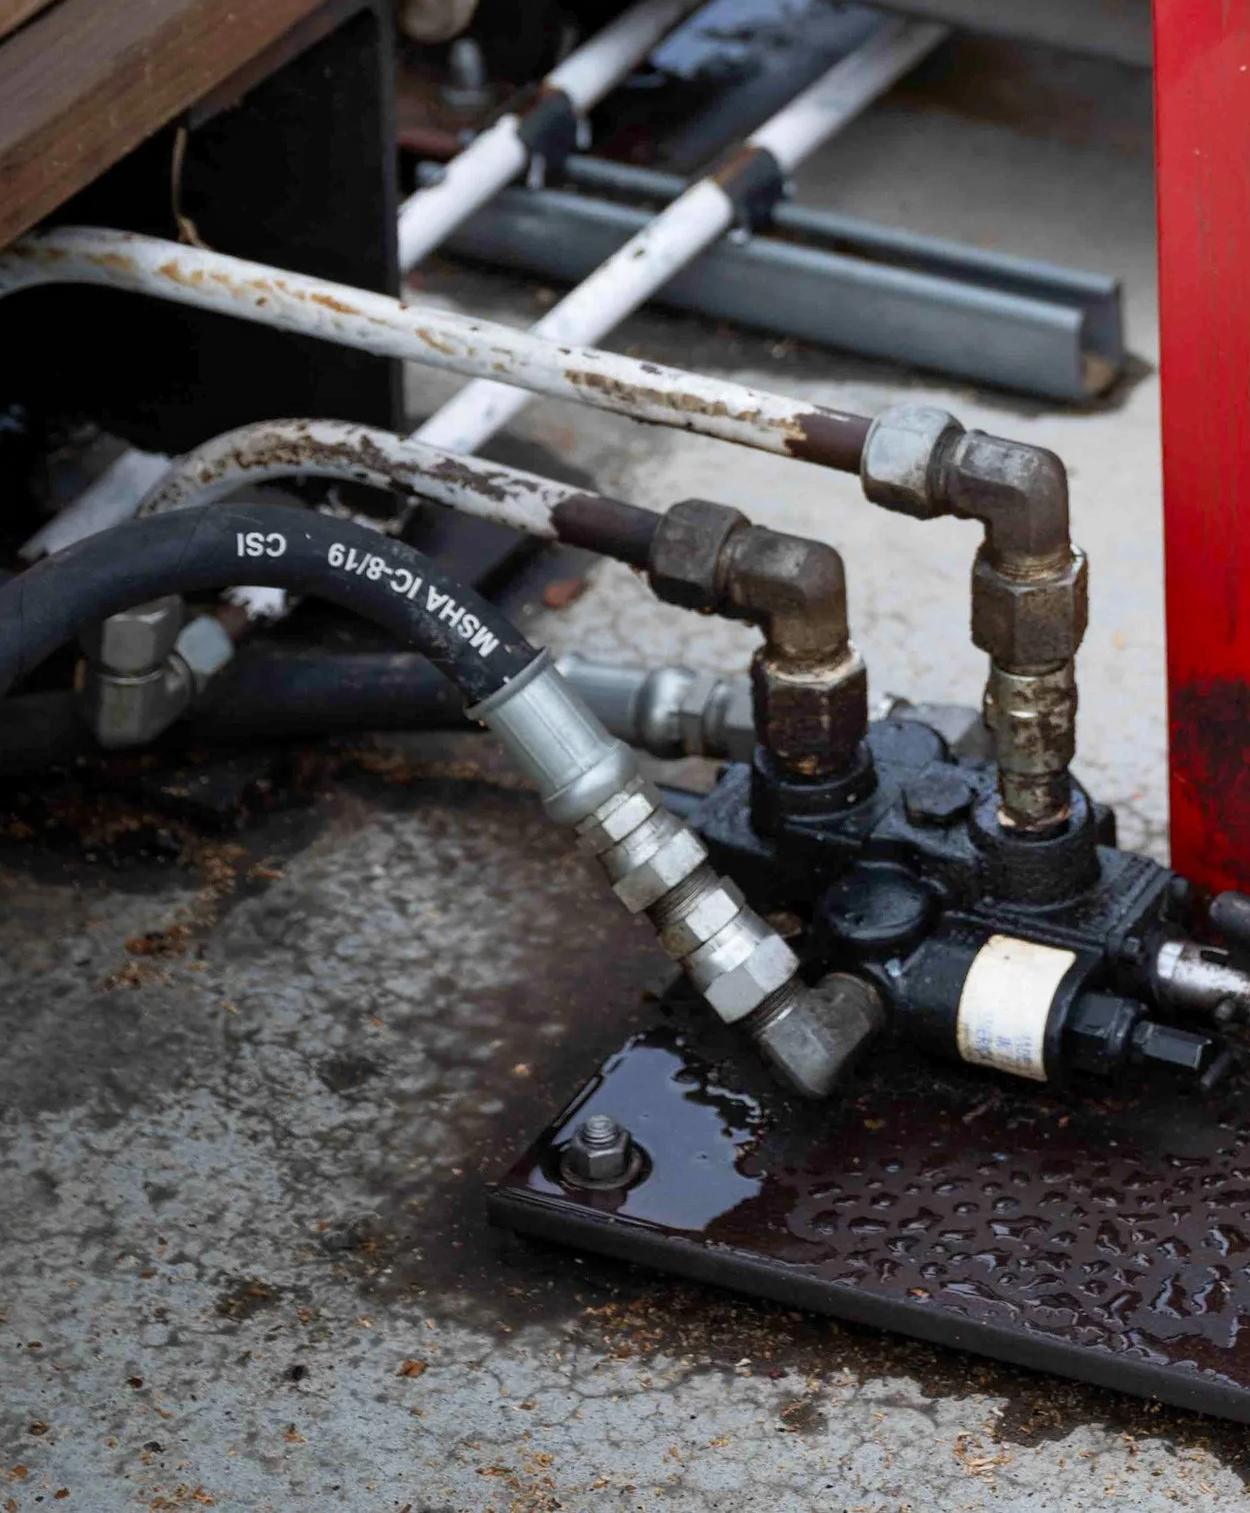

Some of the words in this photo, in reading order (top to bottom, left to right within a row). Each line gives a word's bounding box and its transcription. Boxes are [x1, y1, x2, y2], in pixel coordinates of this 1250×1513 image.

[236, 532, 287, 557] CSI
[327, 542, 423, 600] IC-8/19
[425, 585, 500, 658] MSHA
